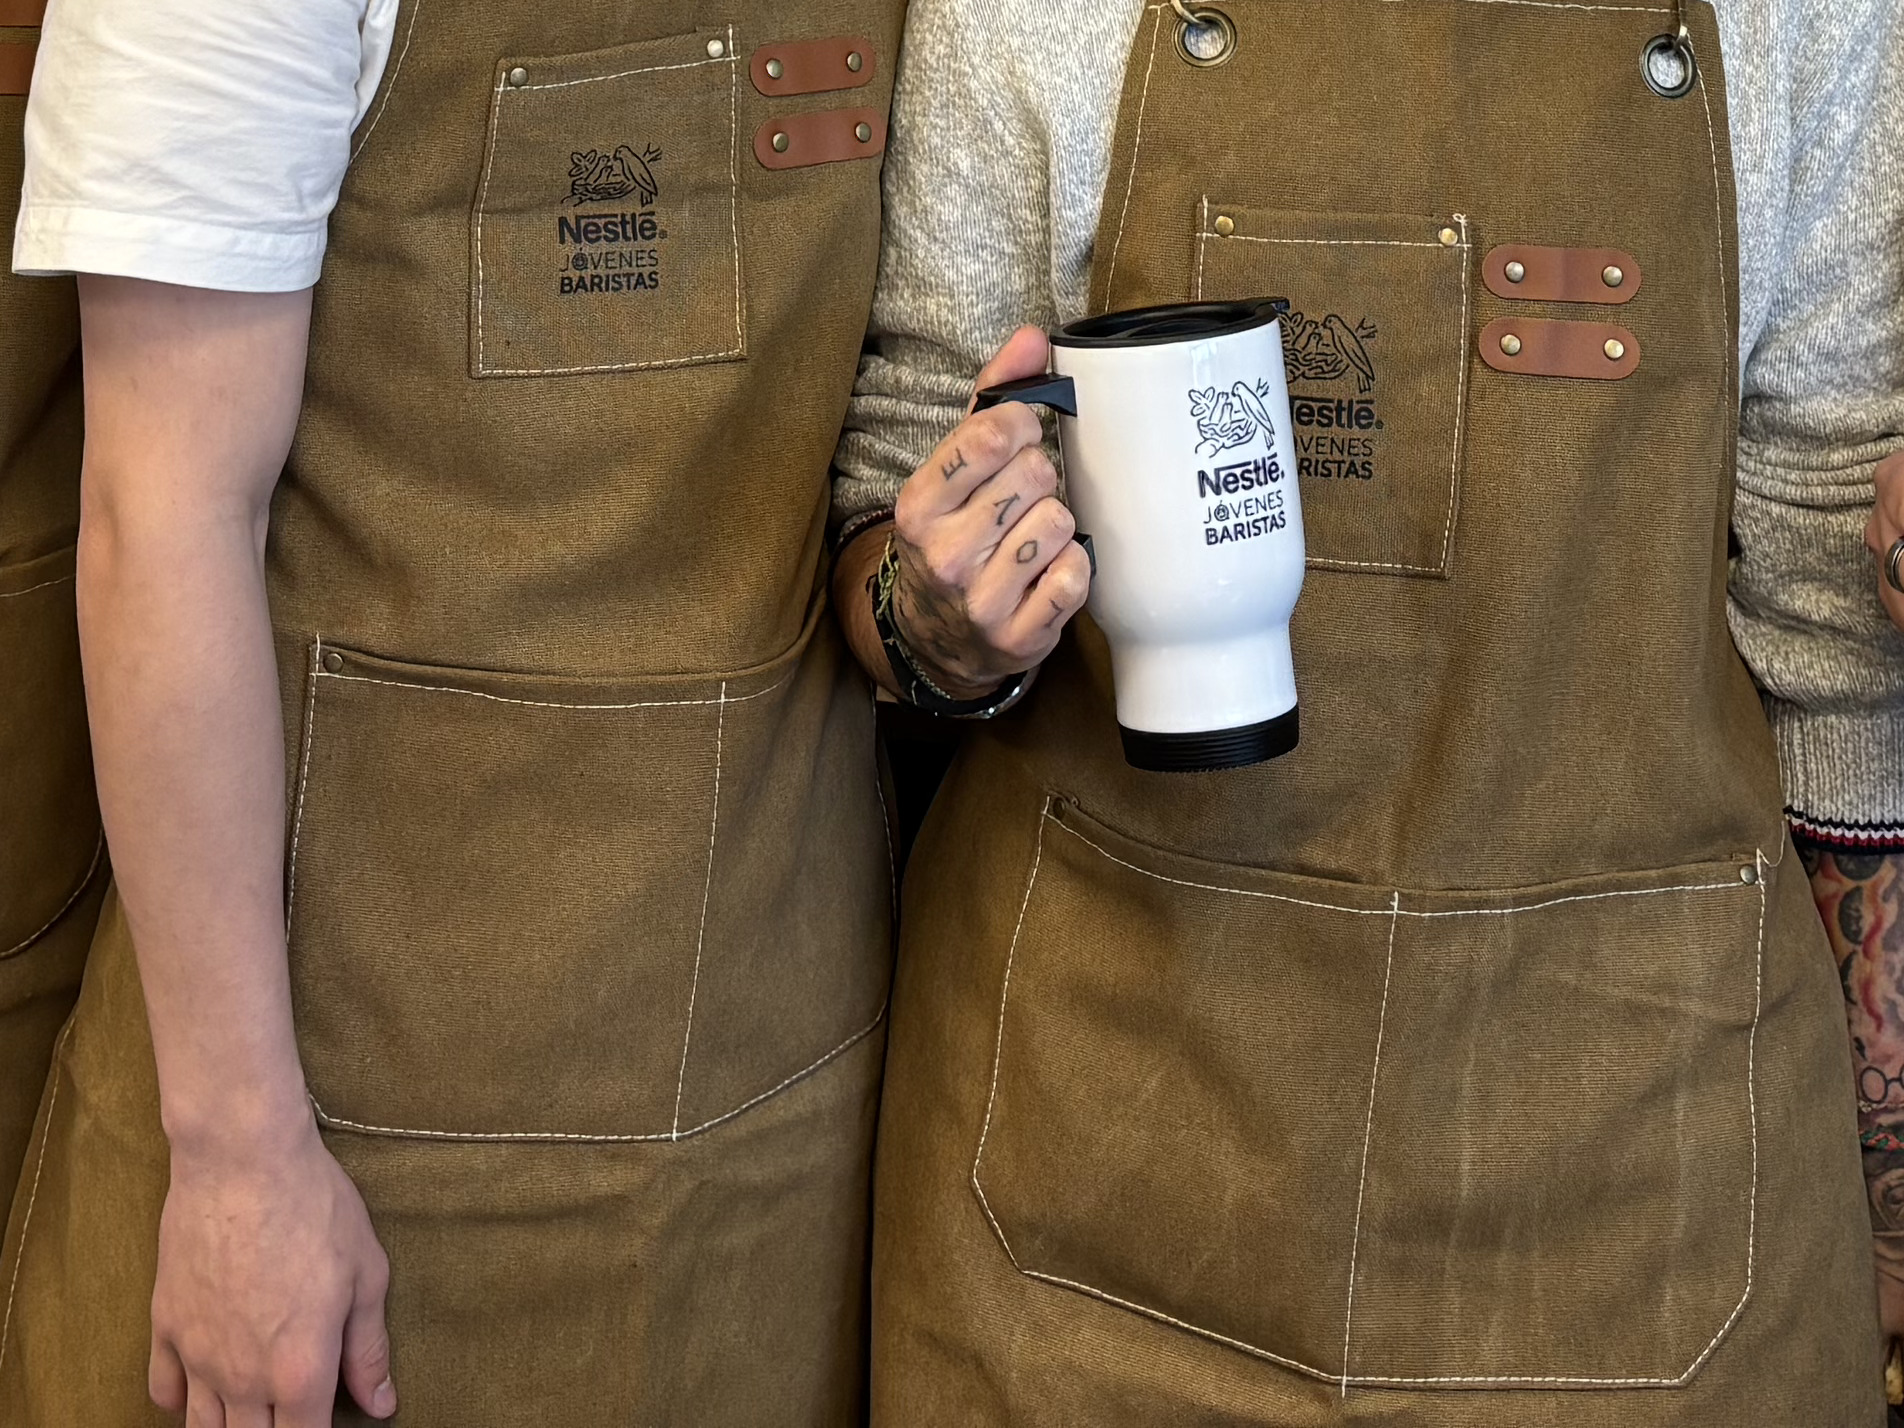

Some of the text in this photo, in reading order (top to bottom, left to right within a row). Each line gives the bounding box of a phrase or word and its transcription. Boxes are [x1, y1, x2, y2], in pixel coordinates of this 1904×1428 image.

[558, 211, 658, 245] Nestlé
[560, 247, 659, 273] JÓVENES
[560, 270, 660, 295] BARISTAS
[1291, 395, 1376, 430] estlé
[1295, 435, 1374, 457] VENES
[1197, 451, 1281, 498] Nestlé
[1298, 457, 1374, 480] RISTAS
[1203, 489, 1284, 525] JÓVENES
[1205, 510, 1287, 546] BARISTAS
